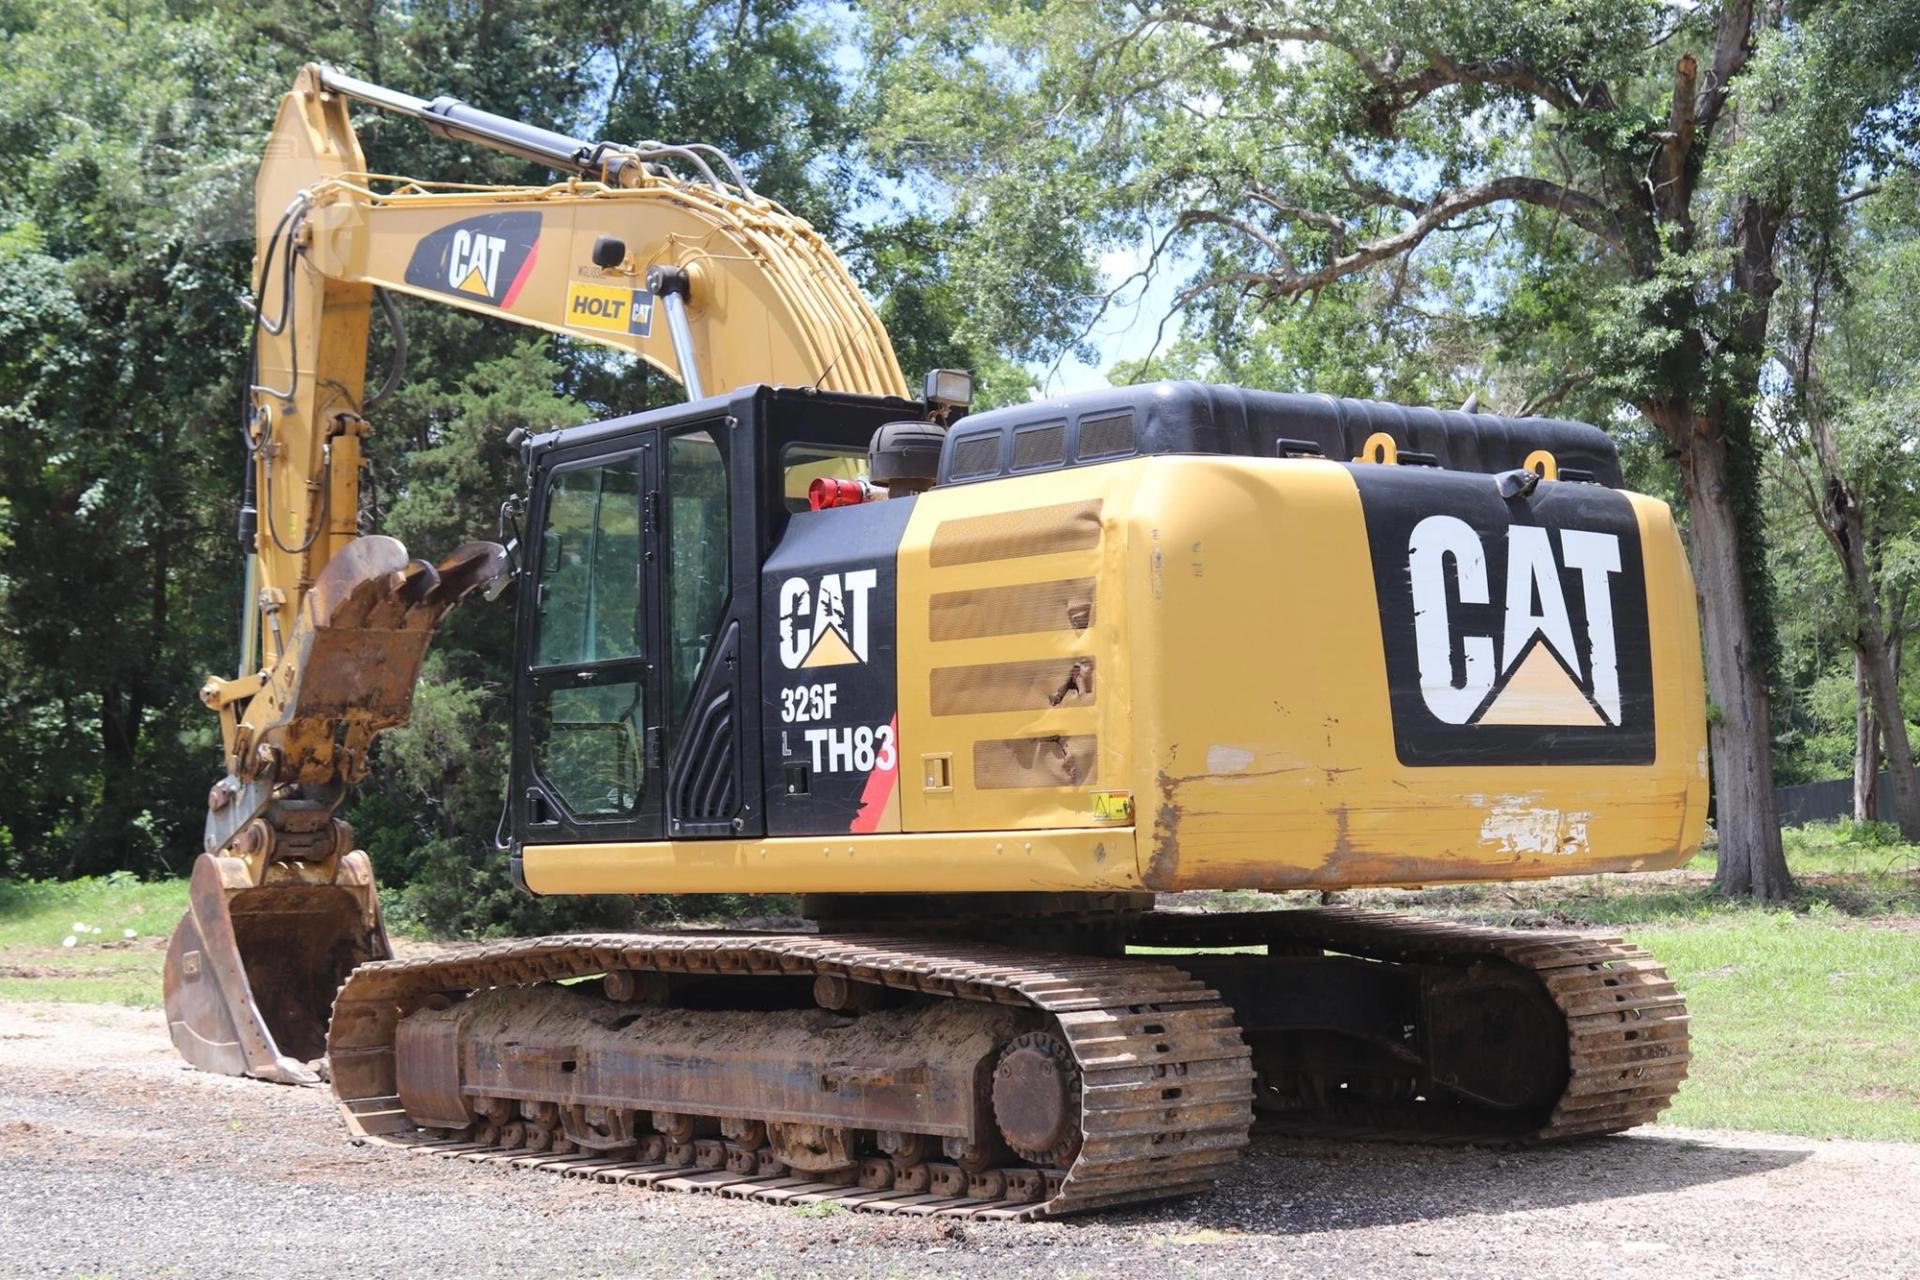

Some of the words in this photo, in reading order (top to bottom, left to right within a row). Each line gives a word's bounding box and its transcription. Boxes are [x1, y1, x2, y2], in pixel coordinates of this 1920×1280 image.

[449, 229, 506, 298] CAT
[573, 295, 625, 319] HOLT
[632, 303, 651, 324] CAT
[780, 569, 877, 670] CAT
[1408, 514, 1623, 727] CAT
[804, 725, 896, 773] TH83
